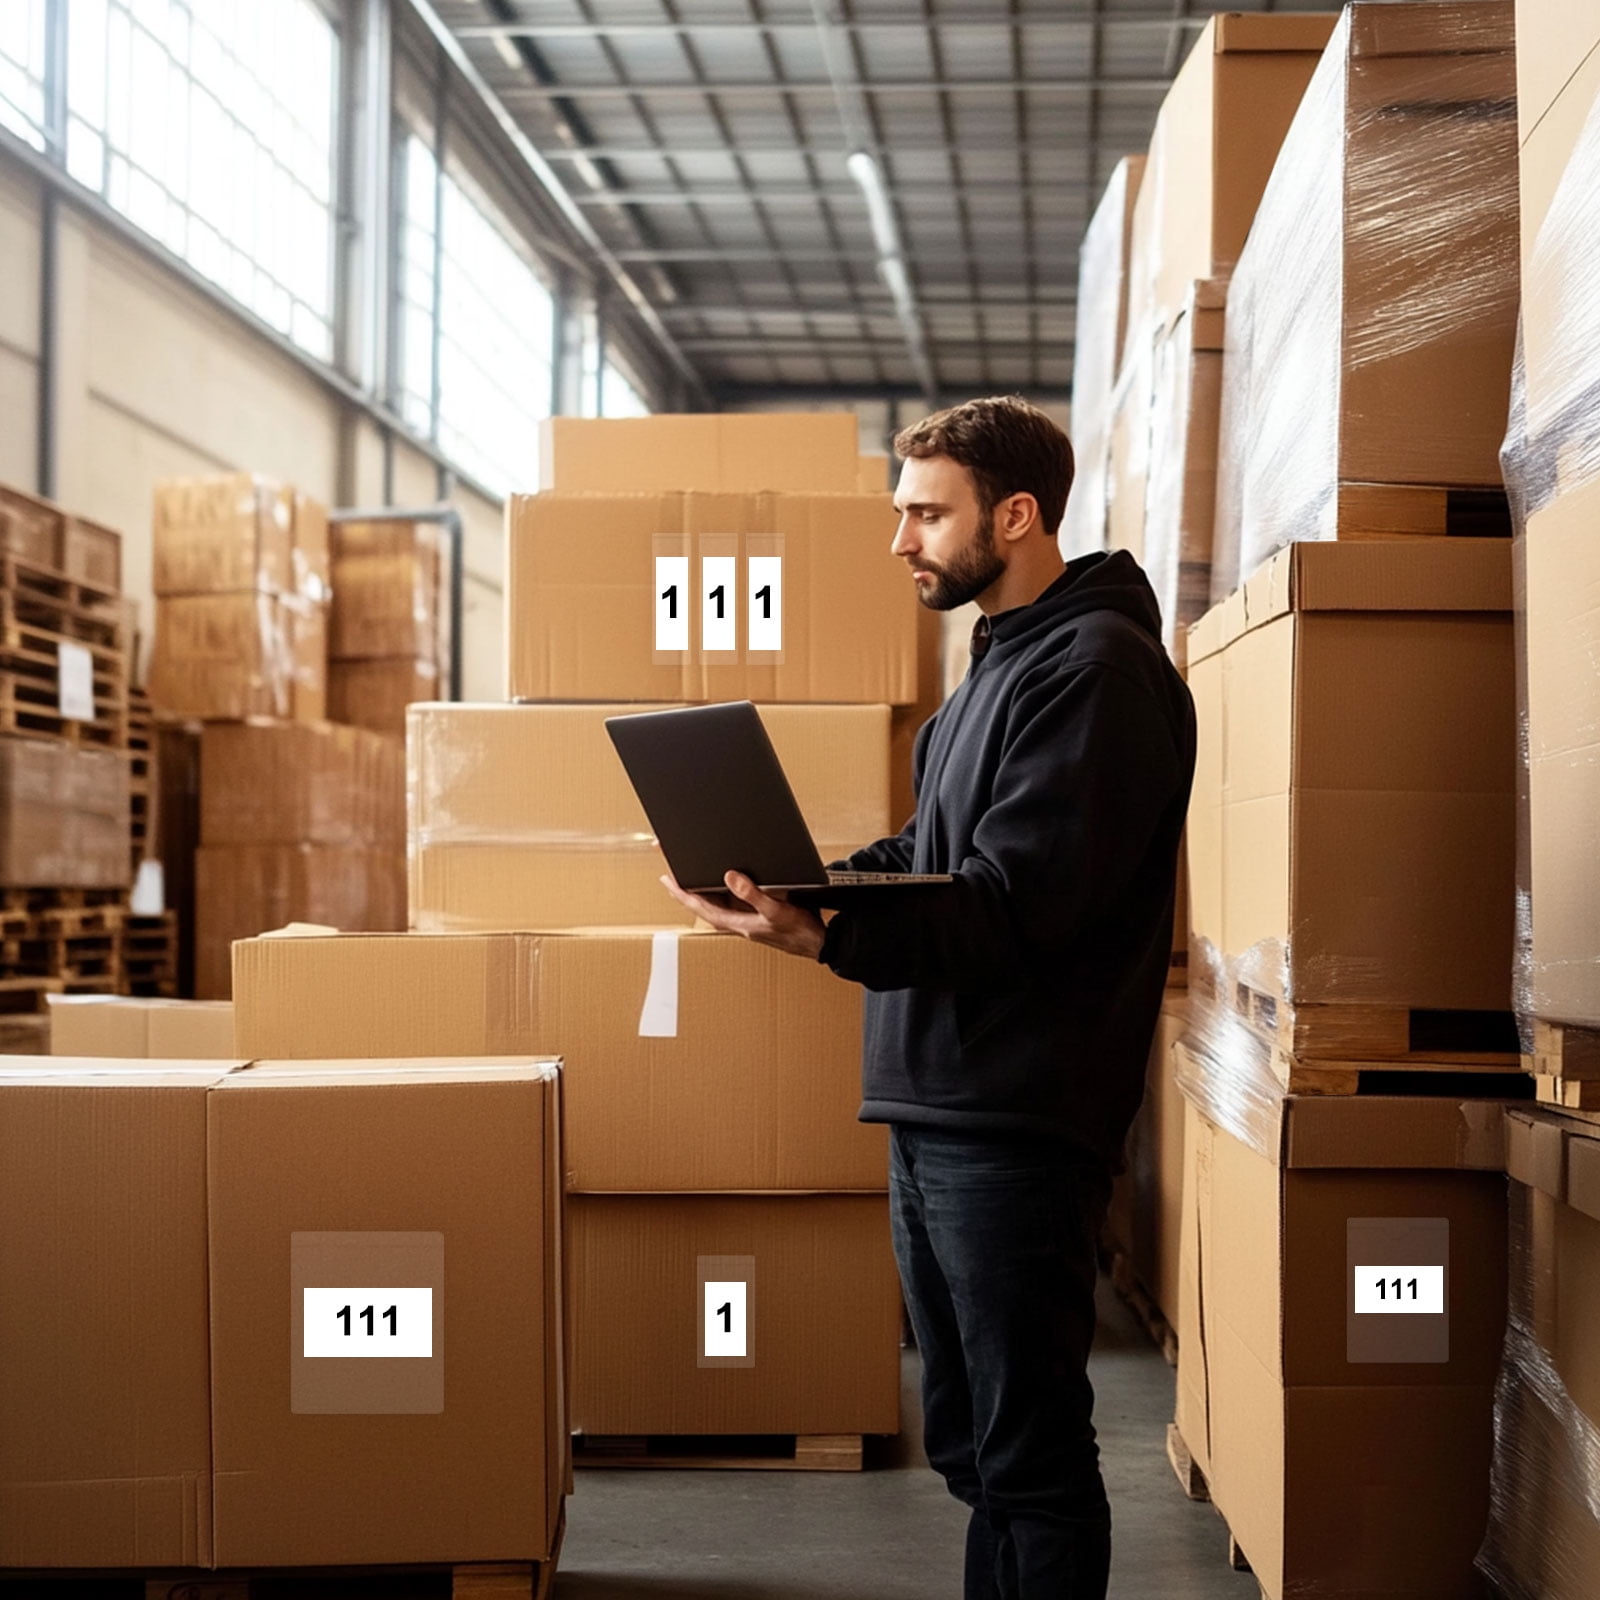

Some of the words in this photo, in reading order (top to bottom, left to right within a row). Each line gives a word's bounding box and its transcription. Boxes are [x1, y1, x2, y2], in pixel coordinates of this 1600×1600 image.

[661, 585, 677, 619] 1
[708, 585, 725, 619] 1
[754, 585, 771, 619] 1
[1375, 1278, 1418, 1300] 111
[335, 1305, 398, 1336] 111
[715, 1302, 731, 1333] 1
